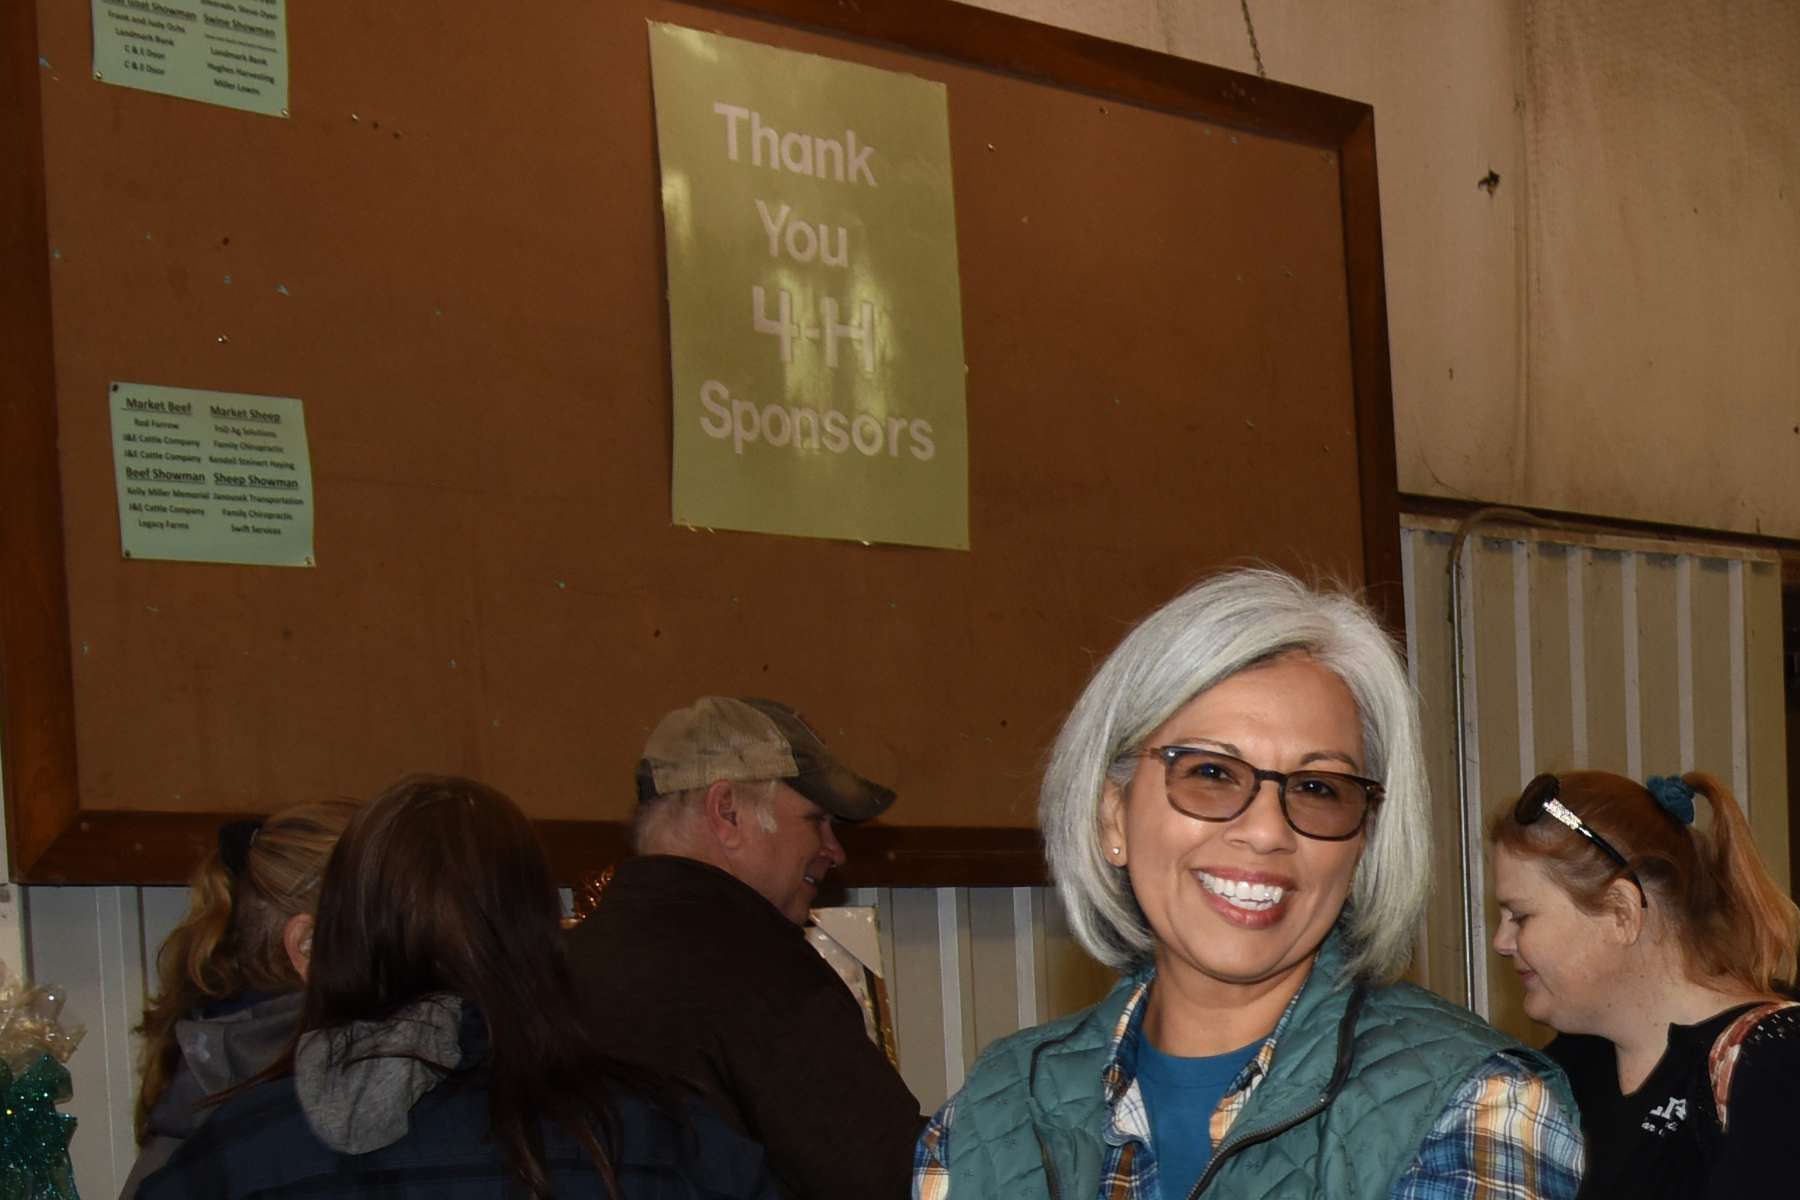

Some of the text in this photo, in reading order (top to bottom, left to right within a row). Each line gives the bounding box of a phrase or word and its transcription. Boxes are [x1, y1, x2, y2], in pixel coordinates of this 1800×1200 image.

[232, 20, 276, 36] Showman
[713, 100, 879, 187] Thank
[754, 198, 849, 269] You
[752, 284, 875, 374] 4-H
[126, 398, 192, 414] Market Beef
[210, 405, 281, 423] Market Sheep
[700, 379, 936, 462] Sponsors
[164, 437, 200, 448] Company
[165, 453, 201, 464] Company
[126, 467, 205, 482] Beef Showman
[214, 472, 298, 488] Sheep Showman
[249, 494, 304, 506] Transportation
[169, 506, 205, 516] Company
